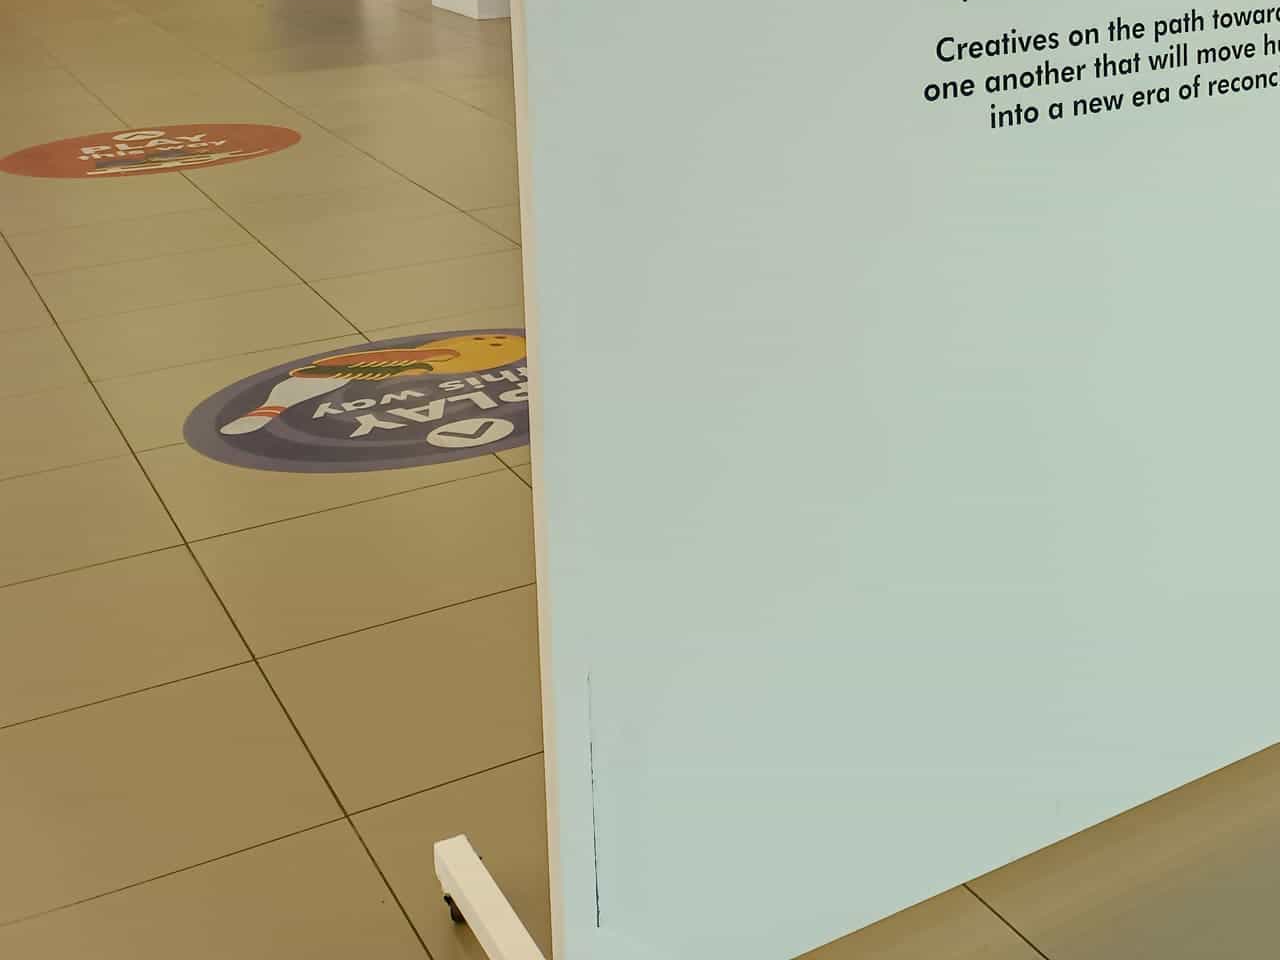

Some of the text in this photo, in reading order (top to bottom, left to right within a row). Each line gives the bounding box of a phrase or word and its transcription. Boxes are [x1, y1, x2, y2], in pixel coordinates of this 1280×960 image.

[936, 29, 1059, 62] Creatives
[1068, 27, 1100, 47] on
[1108, 16, 1145, 42] the
[1154, 8, 1204, 43] path
[923, 78, 975, 102] one
[985, 60, 1086, 94] another
[1094, 53, 1141, 78] that
[1149, 43, 1188, 70] will
[1197, 42, 1256, 65] move
[990, 103, 1039, 129] into
[1048, 102, 1063, 120] a
[1073, 93, 1124, 116] new
[1132, 87, 1170, 107] era
[1178, 75, 1201, 100] of
[312, 390, 424, 419] way
